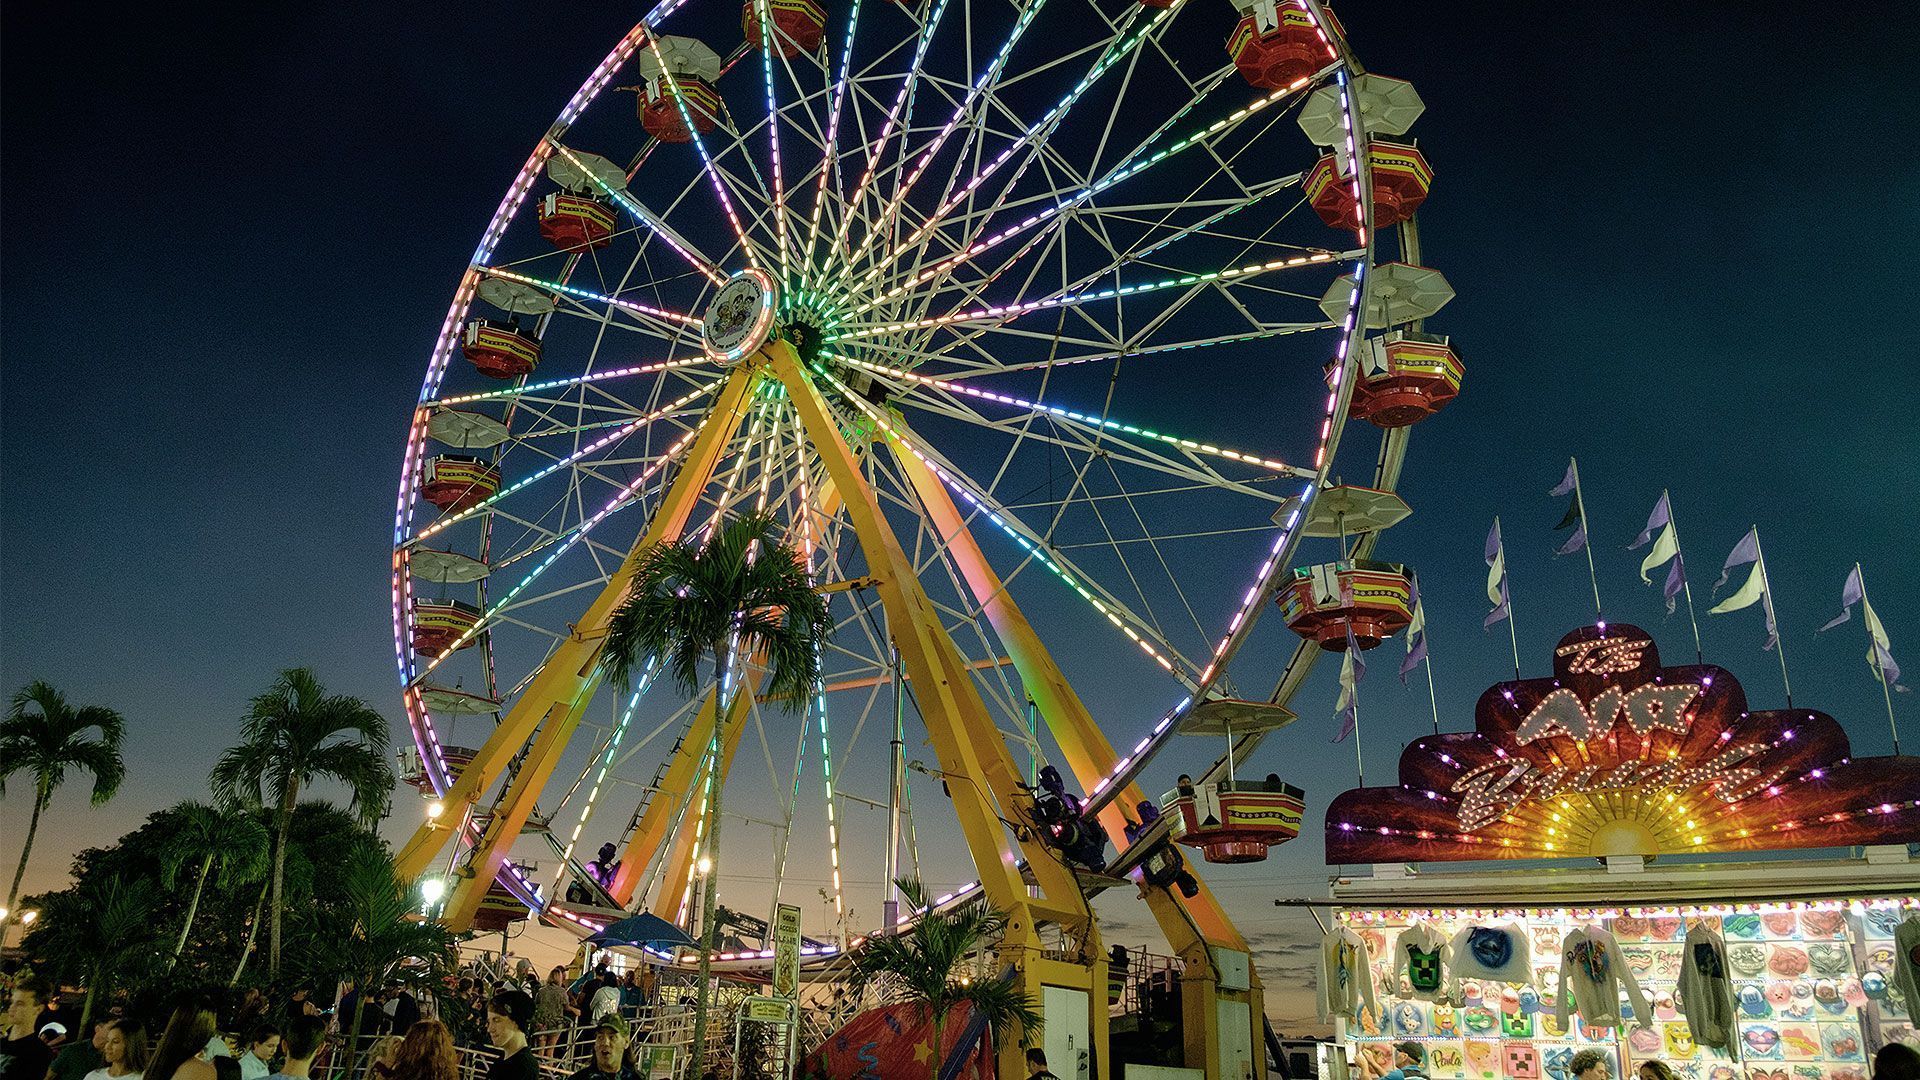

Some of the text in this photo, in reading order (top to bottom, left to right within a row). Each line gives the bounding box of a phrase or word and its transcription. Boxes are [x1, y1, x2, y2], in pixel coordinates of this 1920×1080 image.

[782, 914, 796, 922] GOLD
[779, 924, 798, 933] ACCESS
[1430, 1049, 1463, 1069] Paula
